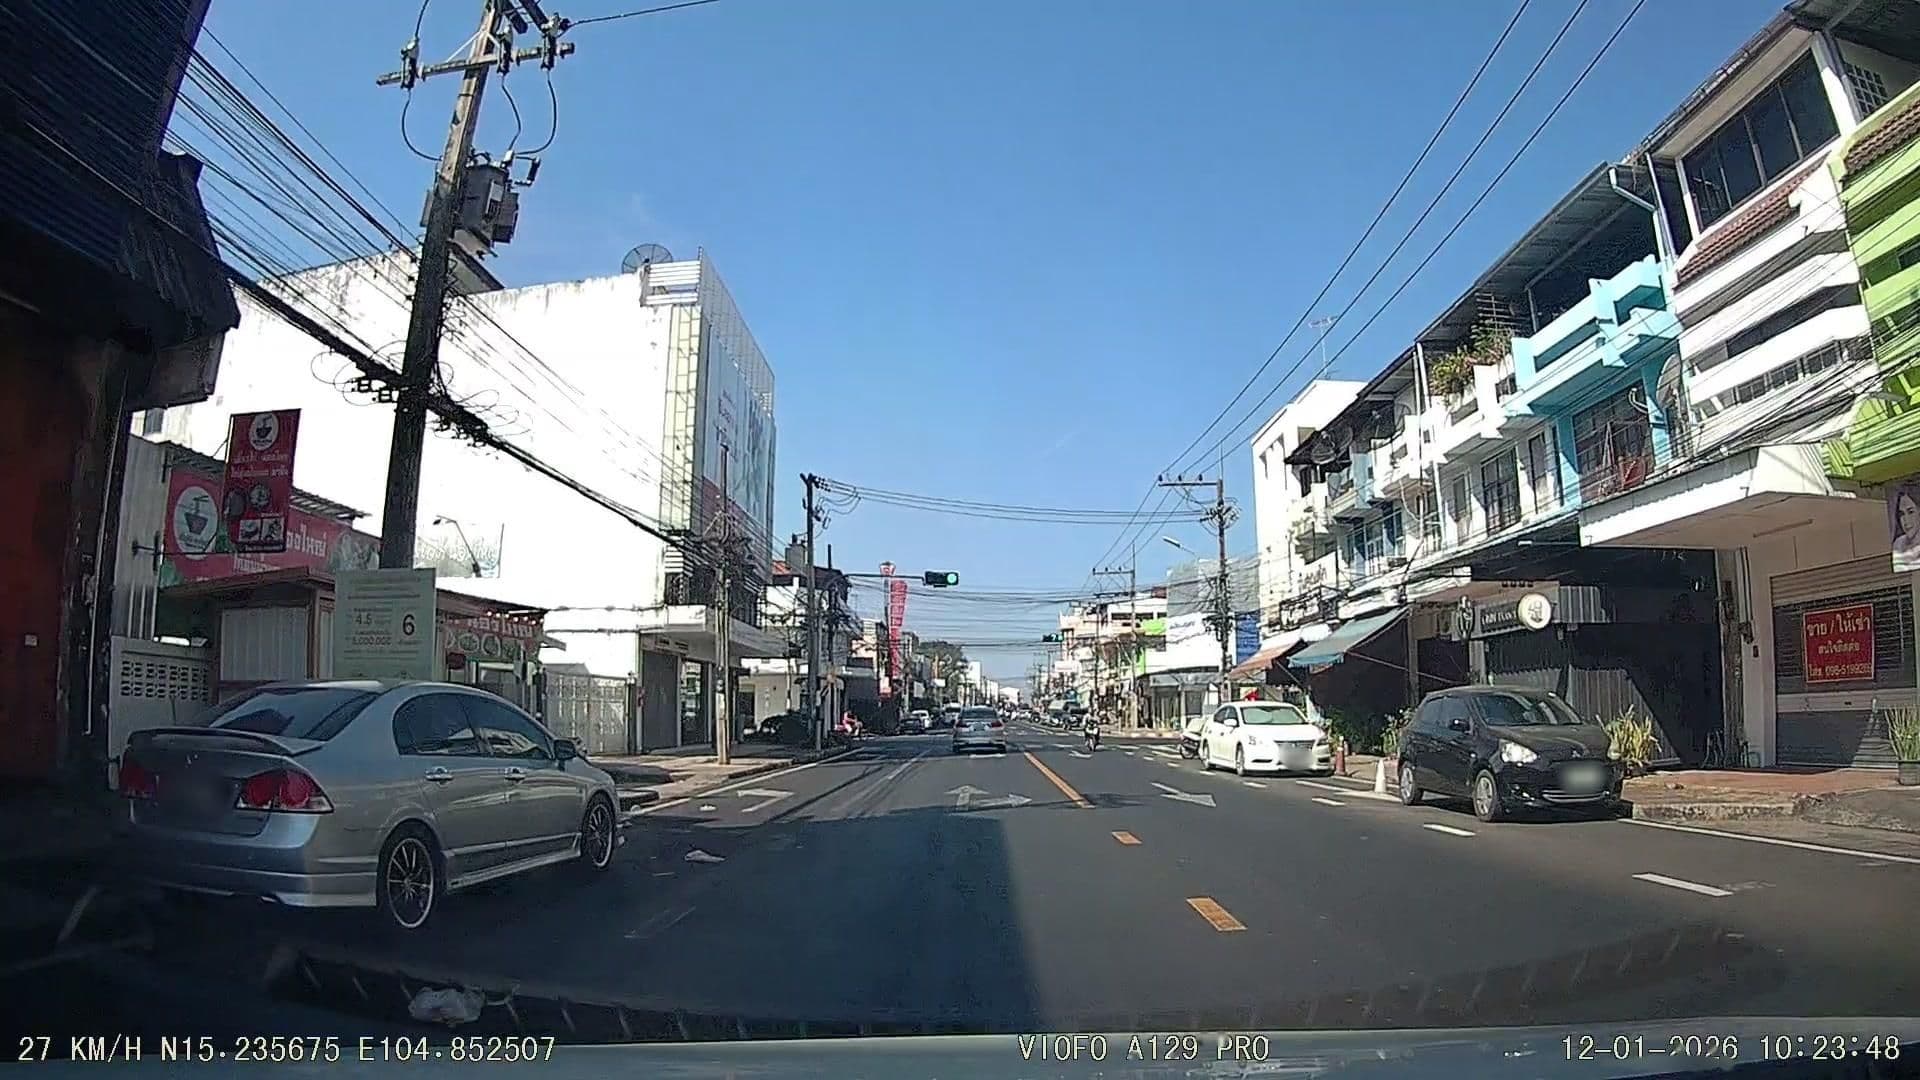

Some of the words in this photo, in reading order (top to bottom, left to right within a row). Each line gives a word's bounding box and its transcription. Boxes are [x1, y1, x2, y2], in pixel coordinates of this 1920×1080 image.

[402, 613, 416, 636] 6
[1808, 624, 1827, 636] ขาย
[1837, 612, 1870, 633] ให้เช่า
